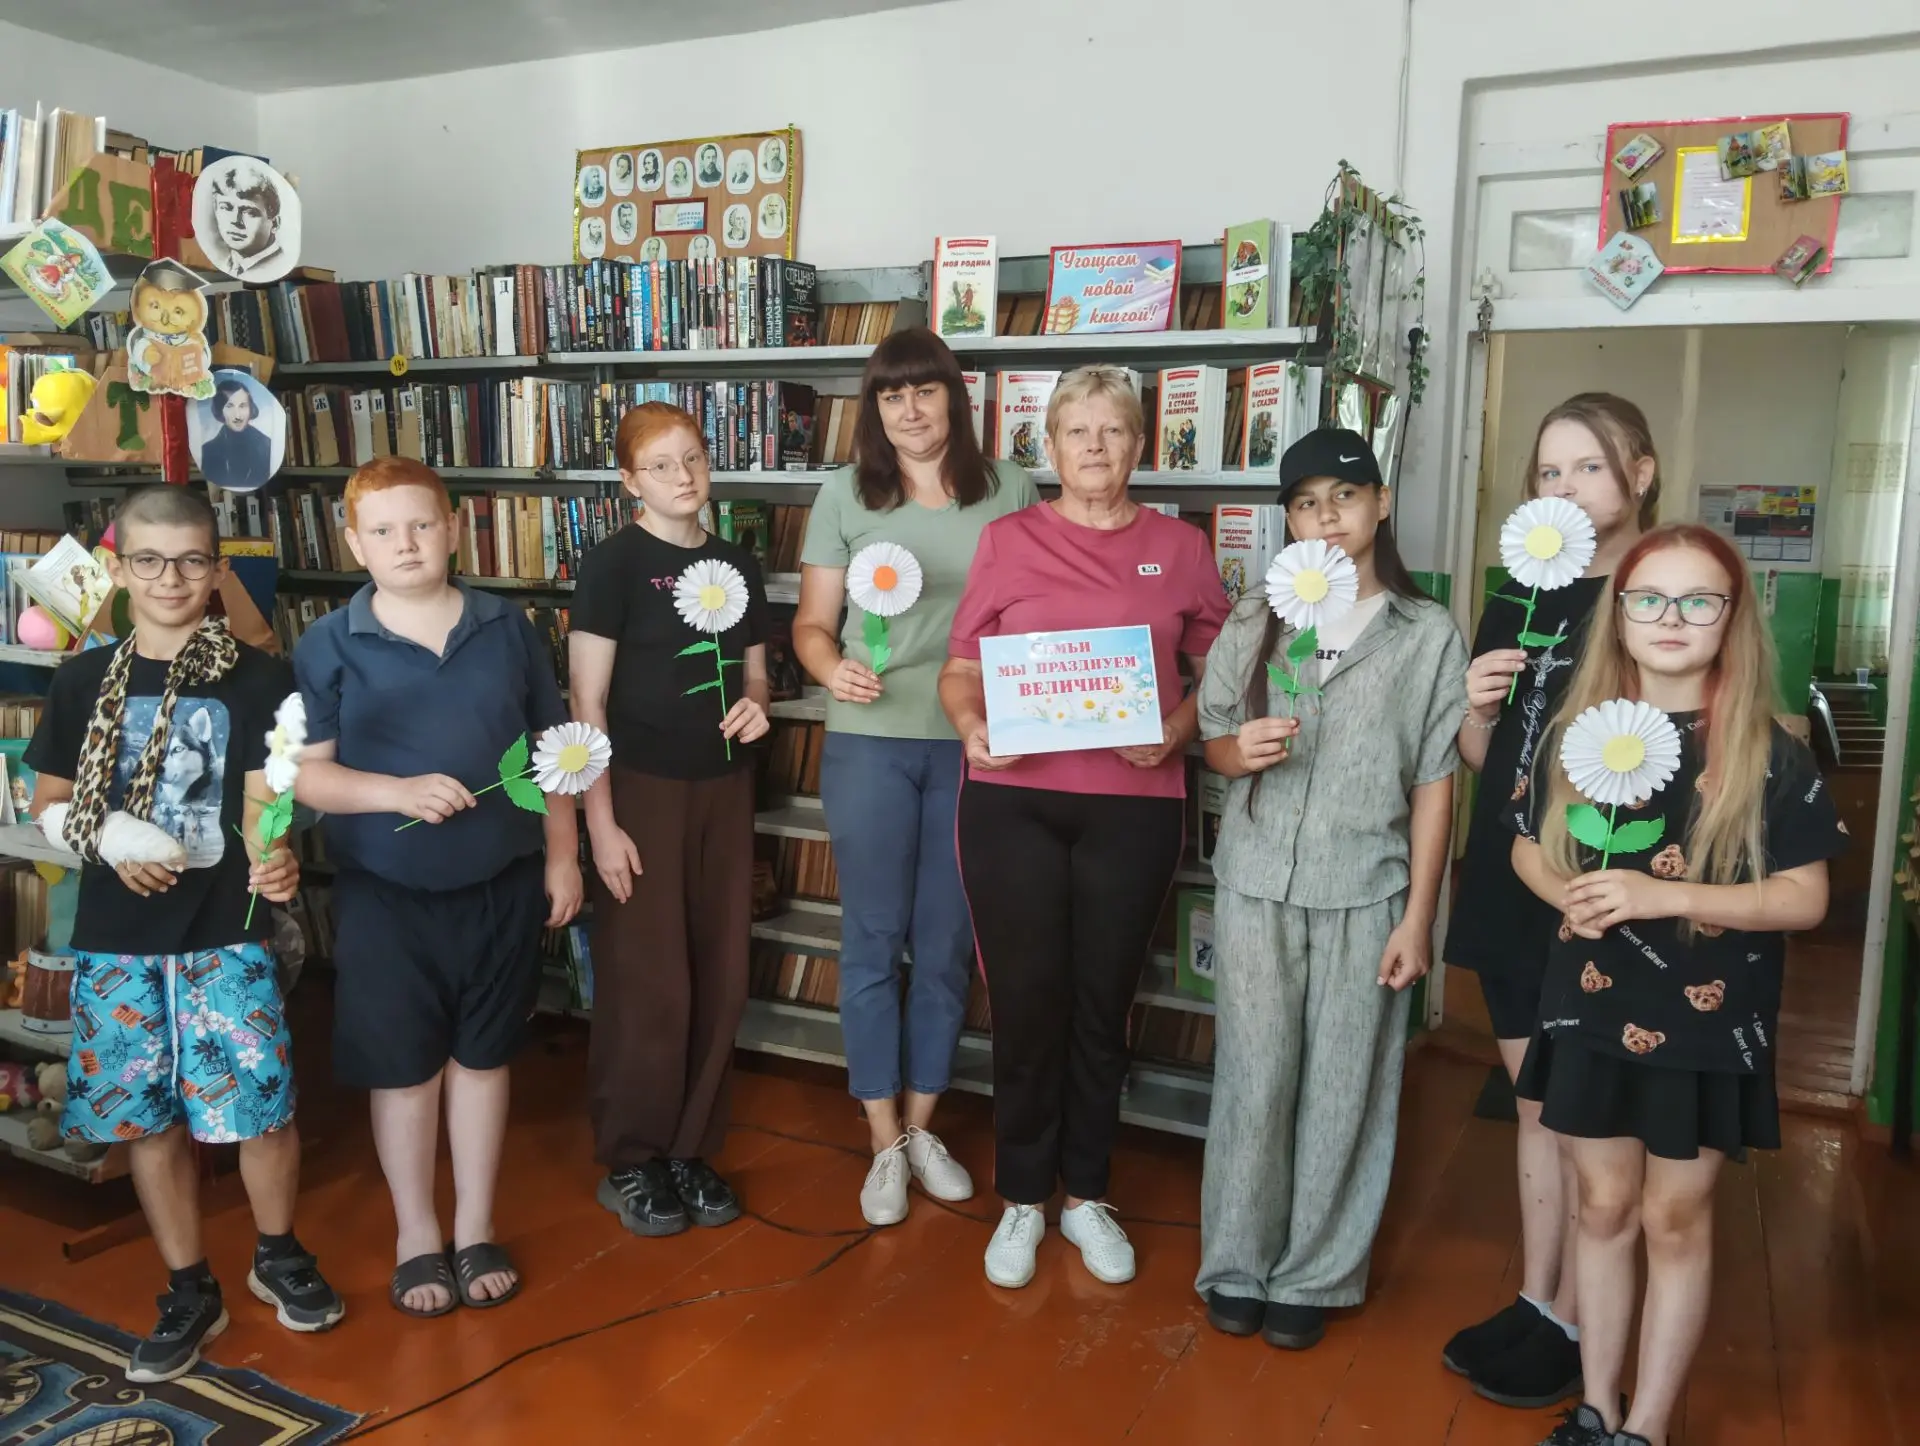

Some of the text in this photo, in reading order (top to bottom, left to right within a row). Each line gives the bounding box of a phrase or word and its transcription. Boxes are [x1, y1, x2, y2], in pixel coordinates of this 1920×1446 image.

[942, 259, 991, 268] МОЯ РОДИНА
[1060, 251, 1137, 274] Угощаем
[1083, 279, 1134, 297] новой
[1088, 305, 1158, 324] книгой!
[766, 307, 774, 346] СПЕЦНАЗ
[774, 307, 783, 346] СПЕЦНАЗ
[1021, 395, 1040, 403] КОТ
[1168, 391, 1197, 400] ГУЛЛИВЕР
[1252, 387, 1280, 398] РАССКАЗЫ
[315, 397, 328, 410] Ж
[1173, 399, 1196, 407] СТРАНЕ
[1257, 397, 1278, 407] СКАЗКИ
[1004, 405, 1011, 413] В
[1164, 406, 1199, 415] ЛИЛИПУТОВ
[997, 656, 1136, 677] МЫ ПРАЗДНУЕМ
[1019, 676, 1121, 697] ВЕЛИЧИЕ!
[1620, 925, 1668, 970] Street Culture
